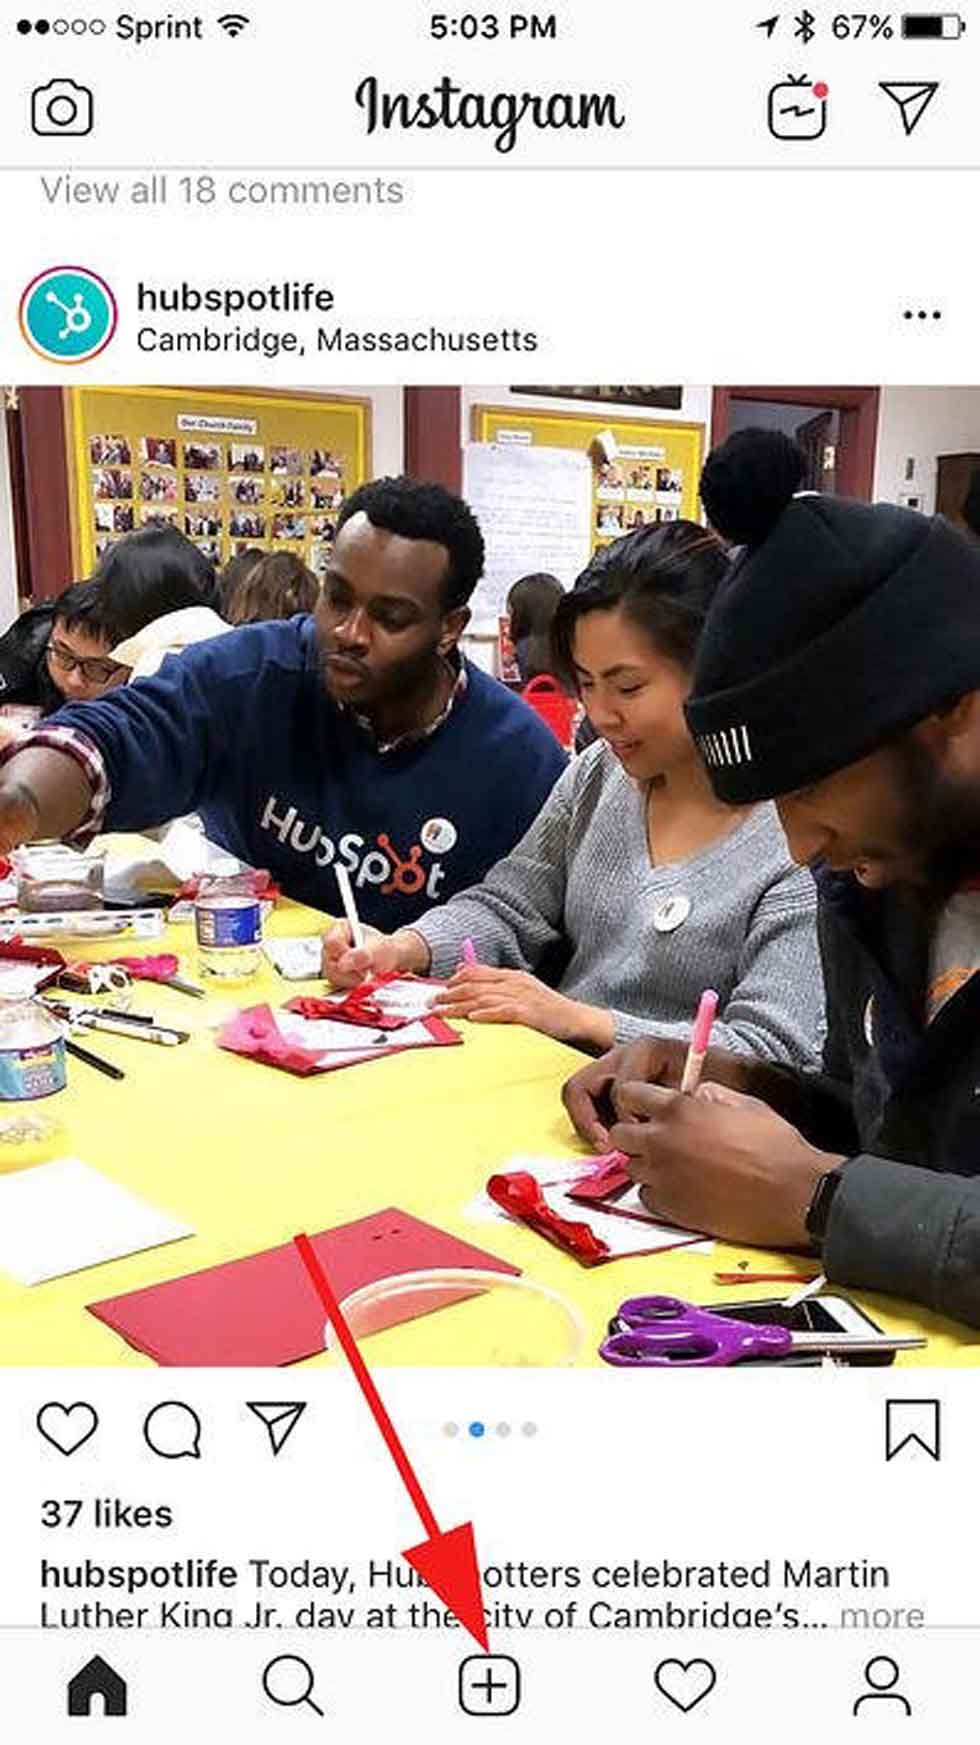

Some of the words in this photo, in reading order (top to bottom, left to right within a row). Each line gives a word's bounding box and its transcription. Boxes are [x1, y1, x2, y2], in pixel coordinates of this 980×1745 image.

[115, 12, 203, 45] Sprint
[430, 13, 500, 41] 5:03
[509, 13, 557, 40] PM
[831, 13, 895, 41] 67%
[354, 75, 626, 155] Instagram
[40, 175, 119, 205] View
[130, 175, 167, 205] all
[179, 176, 217, 205] 18
[228, 178, 404, 205] comments
[137, 281, 335, 318] hubspotlife
[137, 325, 305, 359] Cambridge,
[317, 326, 538, 353] Massachusetts
[40, 1499, 84, 1529] 37
[94, 1497, 173, 1529] likes
[40, 1558, 238, 1595] hubspotlife
[248, 1559, 356, 1596] Today,
[369, 1558, 581, 1589] Huotters
[591, 1559, 771, 1589] celebrated
[783, 1558, 889, 1589] Martin
[40, 1600, 150, 1628] Luther
[160, 1600, 233, 1628] King
[243, 1601, 283, 1628] Jr.
[295, 1600, 356, 1628] day
[365, 1603, 398, 1628] at
[544, 1600, 579, 1628] of
[840, 1606, 925, 1628] more
